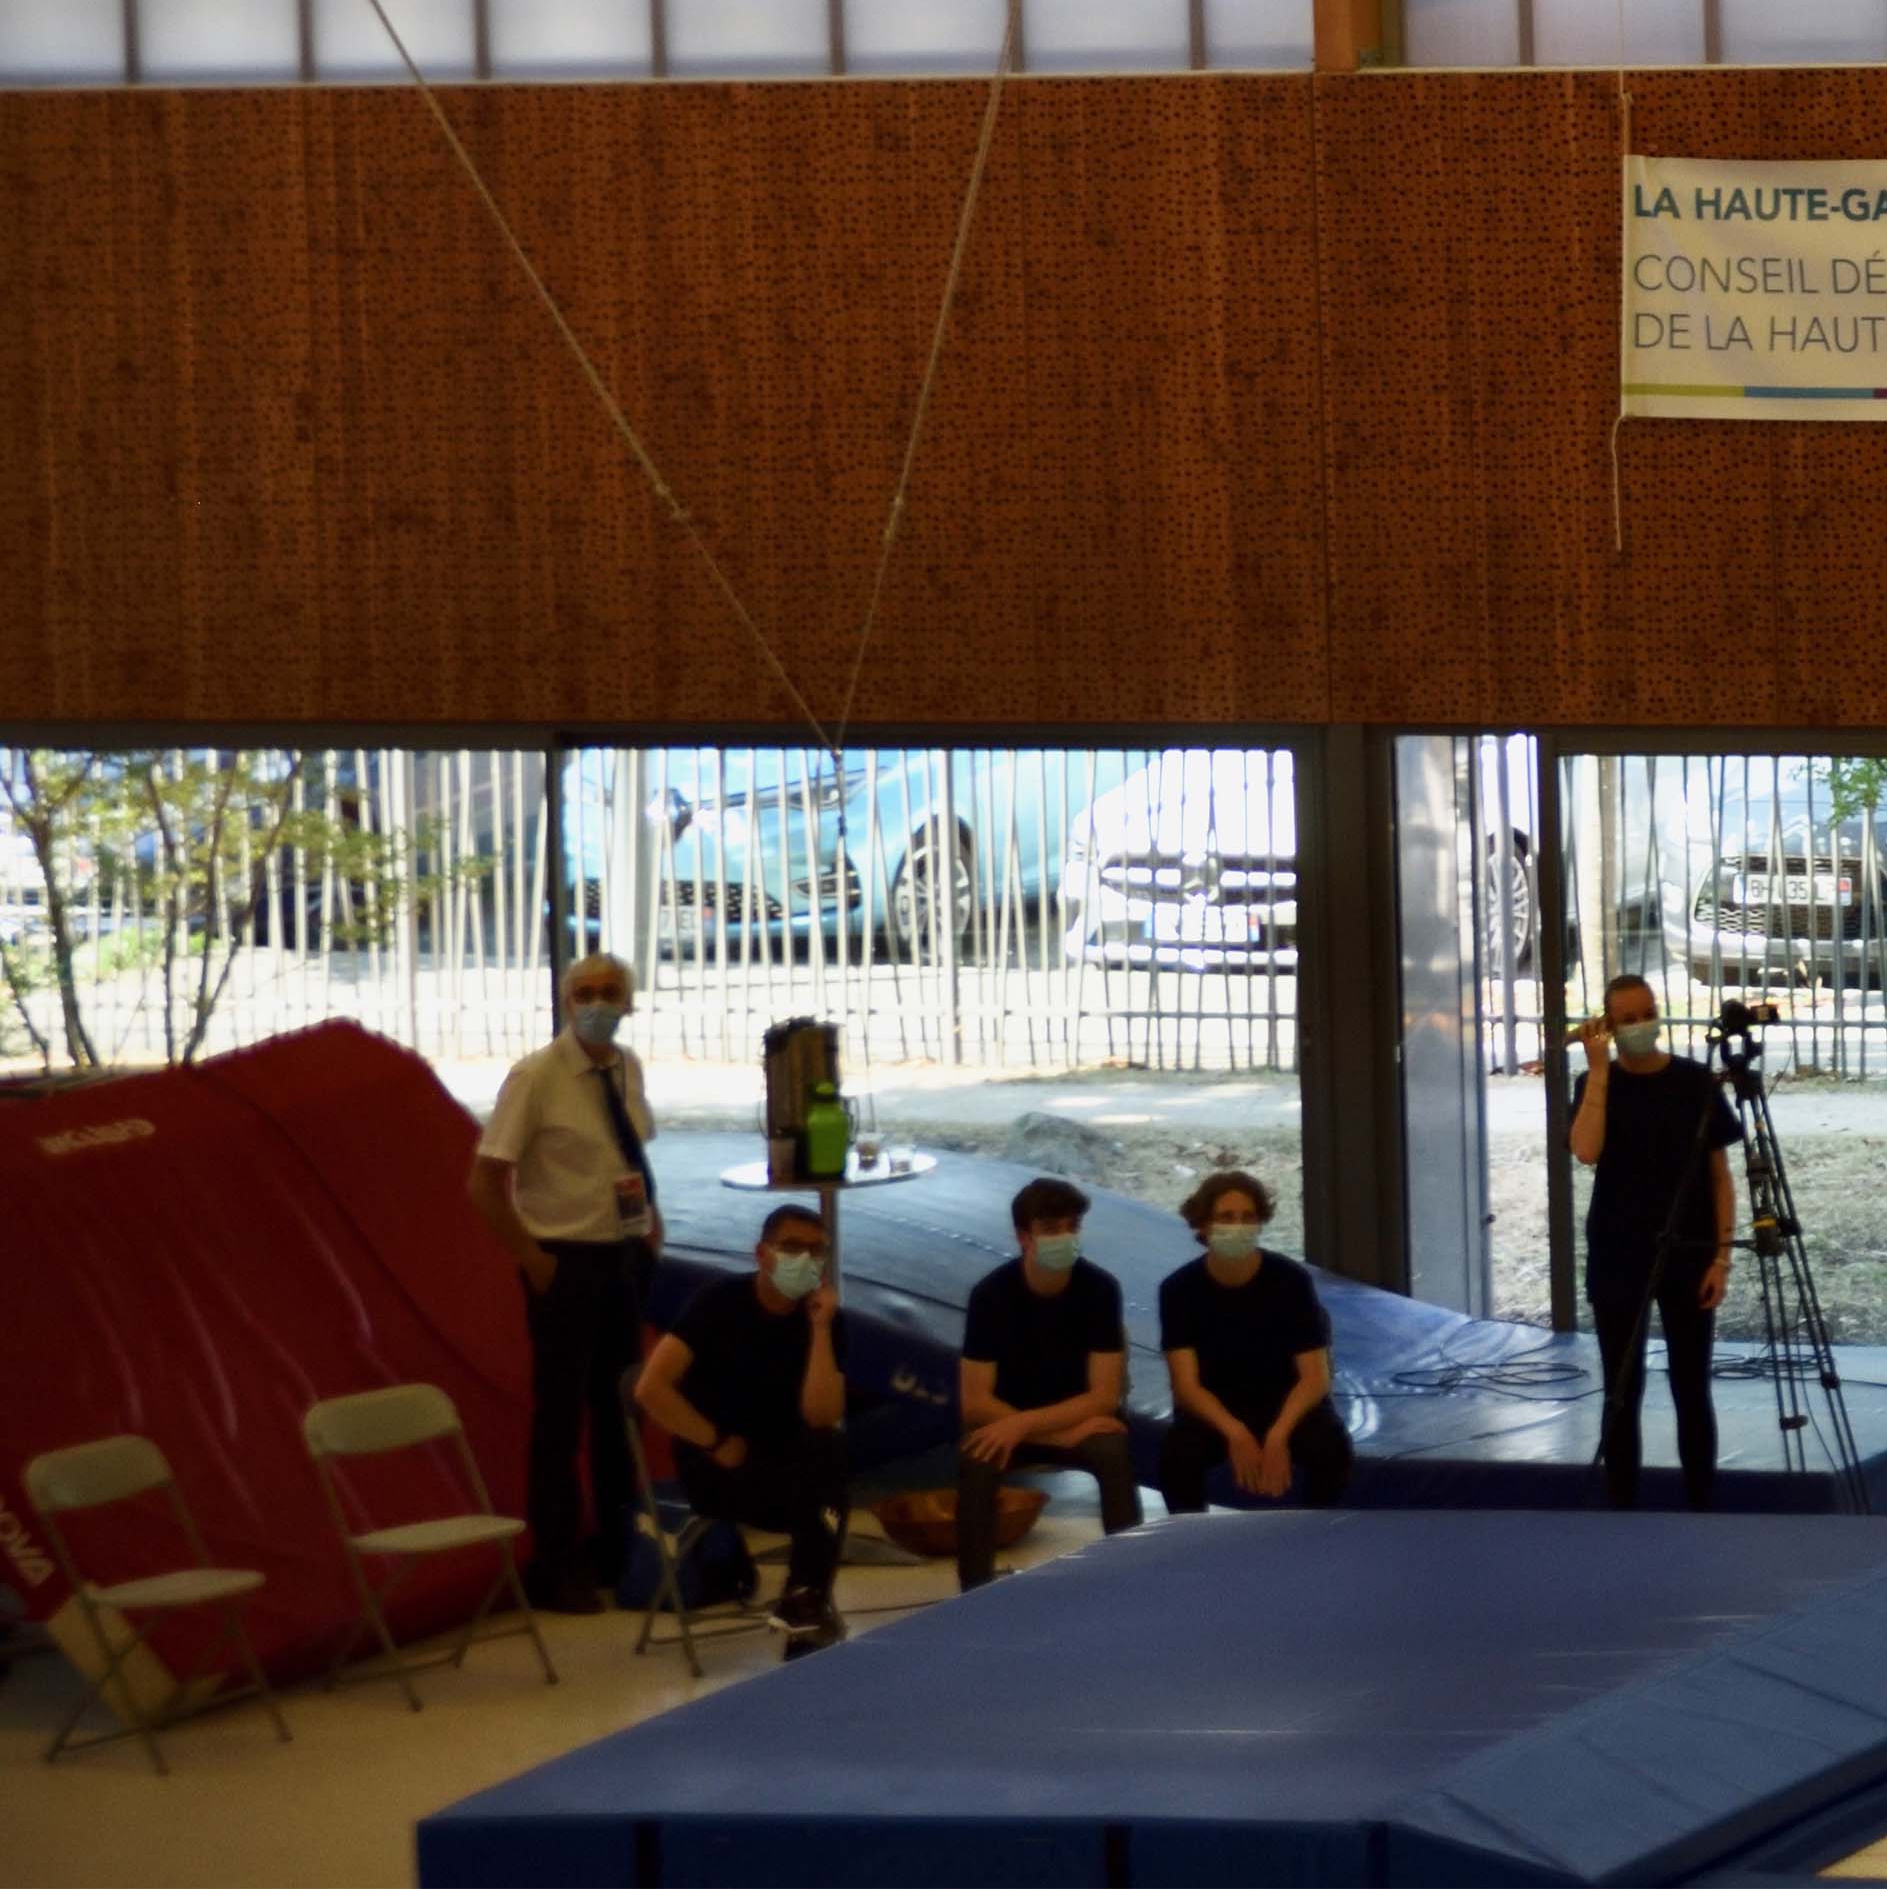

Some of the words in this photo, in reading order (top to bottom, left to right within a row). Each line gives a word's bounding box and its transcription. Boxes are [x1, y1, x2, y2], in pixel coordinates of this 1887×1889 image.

[1633, 184, 1681, 220] LA
[1633, 253, 1820, 295] CONSEIL
[1634, 312, 1692, 350] DE
[1704, 314, 1754, 351] LA
